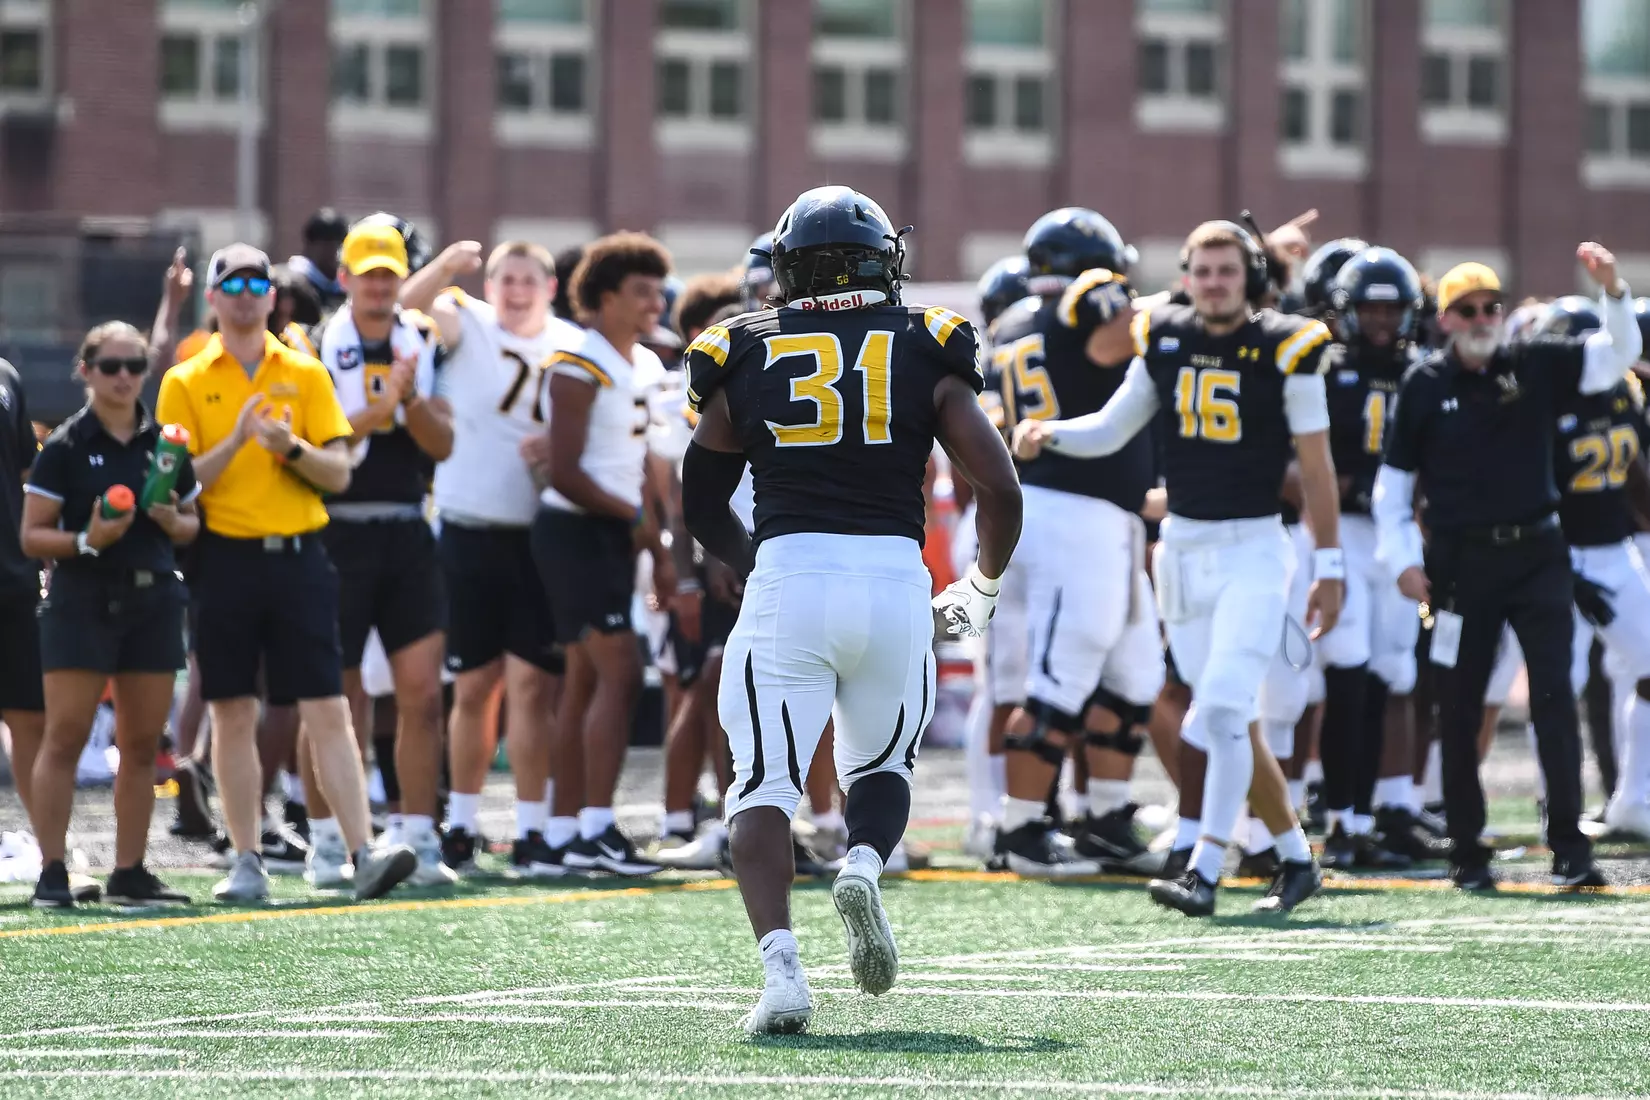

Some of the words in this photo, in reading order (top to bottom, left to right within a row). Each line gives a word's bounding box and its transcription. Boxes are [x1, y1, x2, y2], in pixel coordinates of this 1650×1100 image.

[763, 330, 895, 447] 31
[1174, 366, 1242, 443] 16
[1568, 423, 1640, 492] 20
